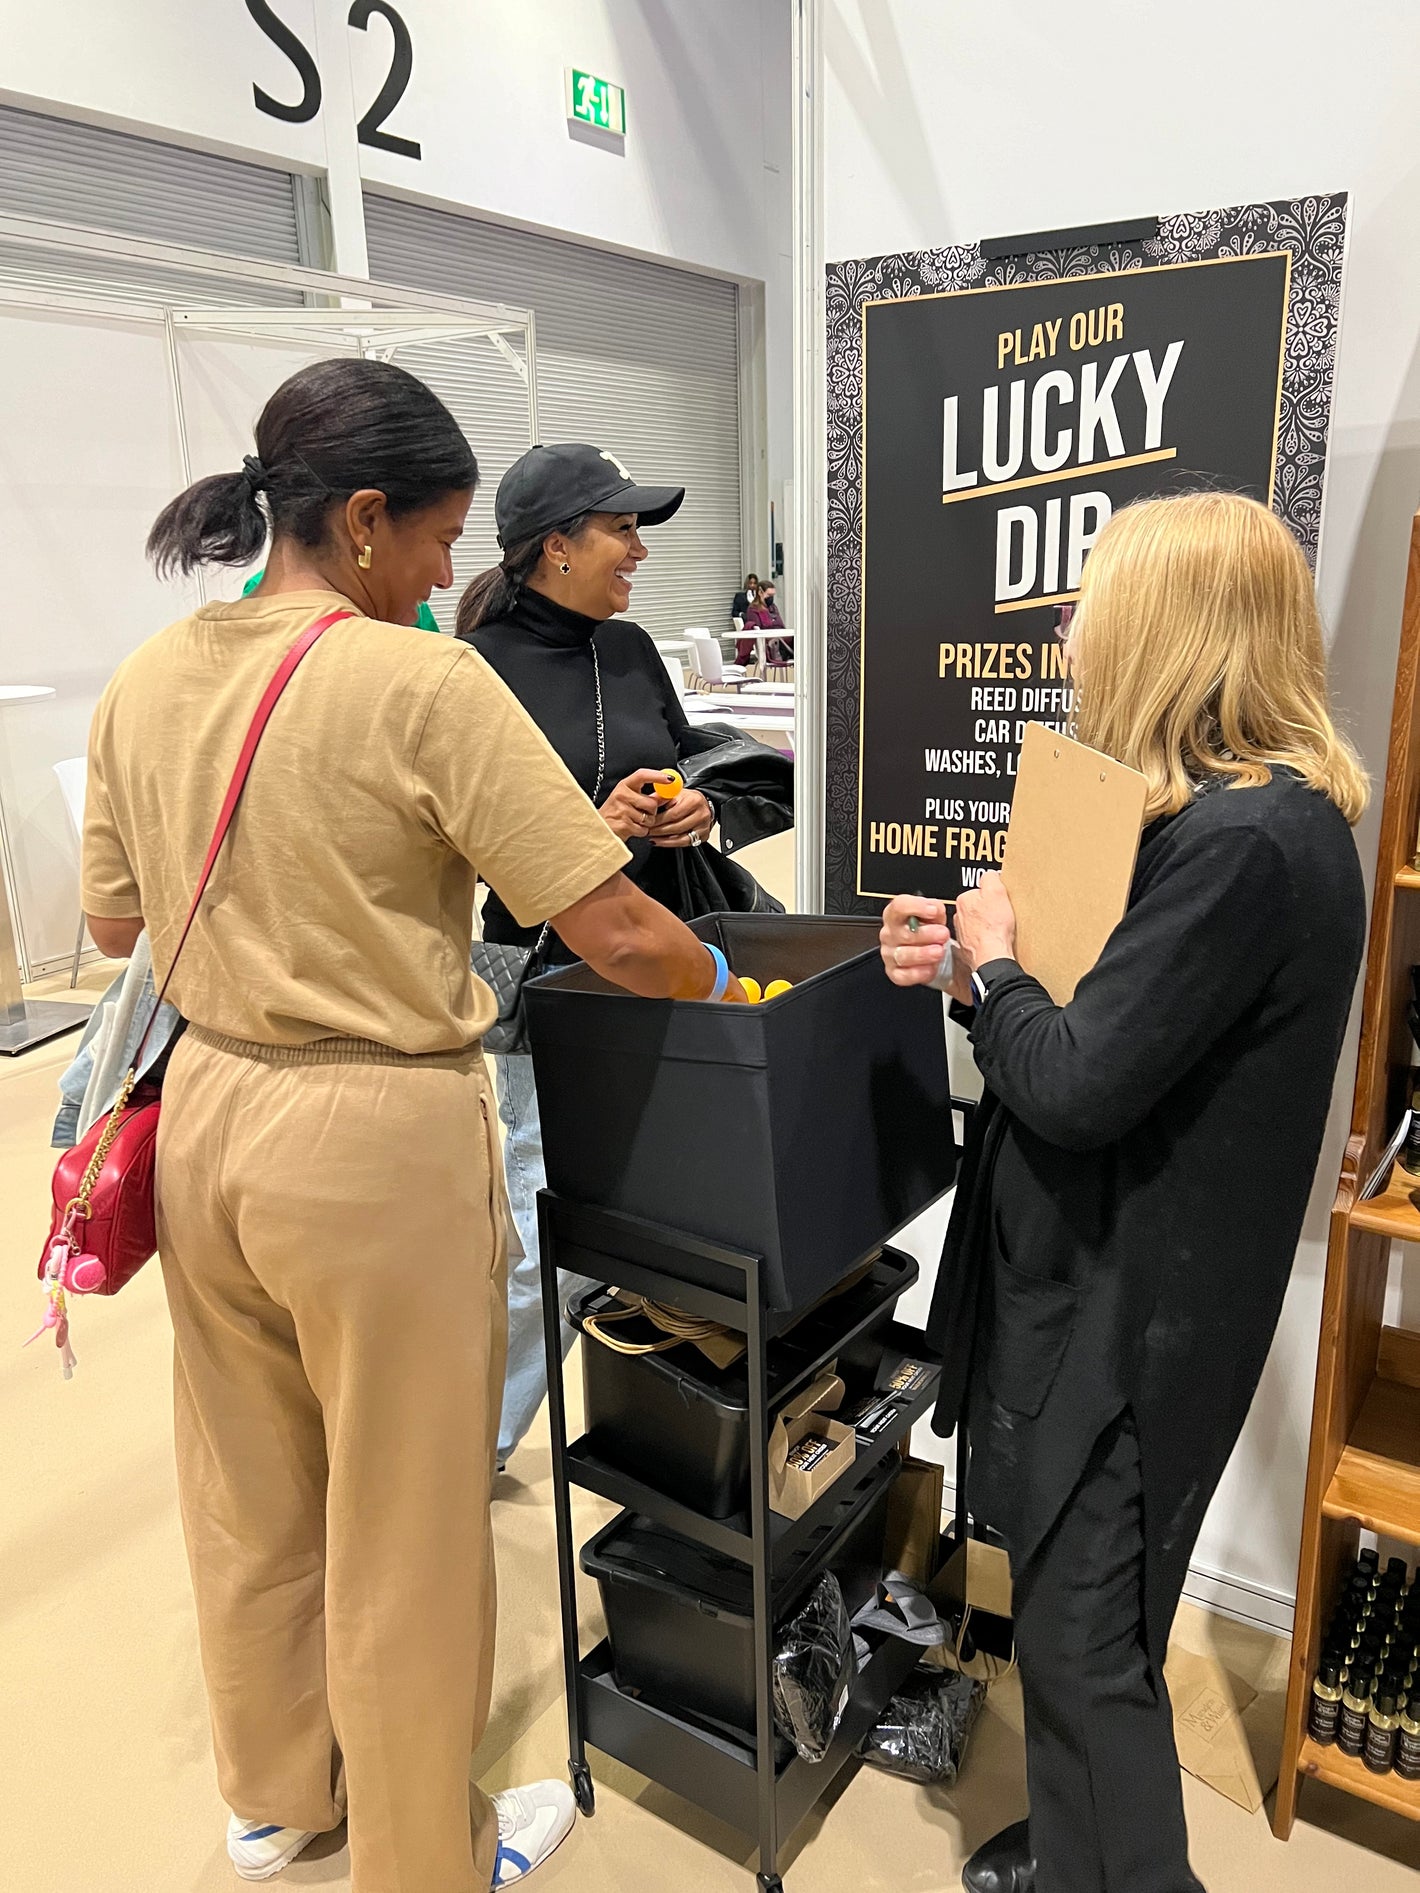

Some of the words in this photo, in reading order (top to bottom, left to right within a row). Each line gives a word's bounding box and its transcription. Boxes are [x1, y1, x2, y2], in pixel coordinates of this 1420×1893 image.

[998, 317, 1063, 370] PLAY
[1069, 302, 1124, 351] OUR
[942, 340, 1185, 492] LUCKY
[938, 642, 1033, 680] PRIZES
[971, 686, 1017, 711] REED
[974, 719, 1010, 744] CAR
[924, 748, 1001, 778] WASHES,
[925, 798, 964, 821] PLUS
[968, 800, 1011, 824] YOUR
[869, 821, 939, 858] HOME
[801, 1438, 821, 1454] OFF
